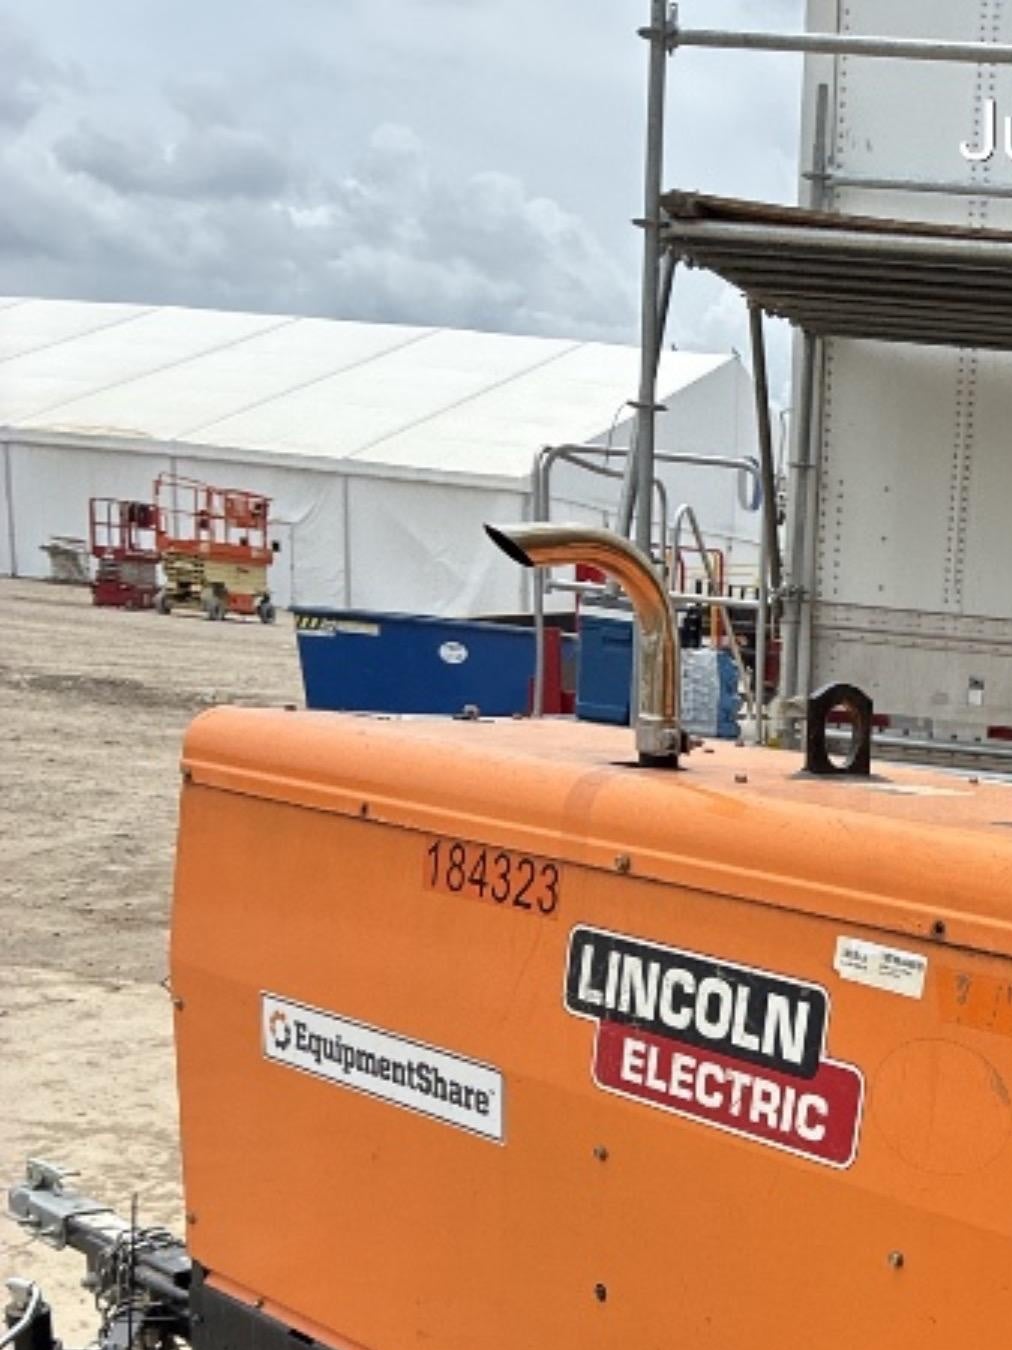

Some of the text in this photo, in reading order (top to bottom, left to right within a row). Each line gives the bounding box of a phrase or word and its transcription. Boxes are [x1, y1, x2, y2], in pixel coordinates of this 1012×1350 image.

[427, 842, 560, 914] 184323
[577, 945, 810, 1062] LINCOLN
[294, 1021, 491, 1118] EquipmentShare
[619, 1038, 828, 1142] ELECTRIC
